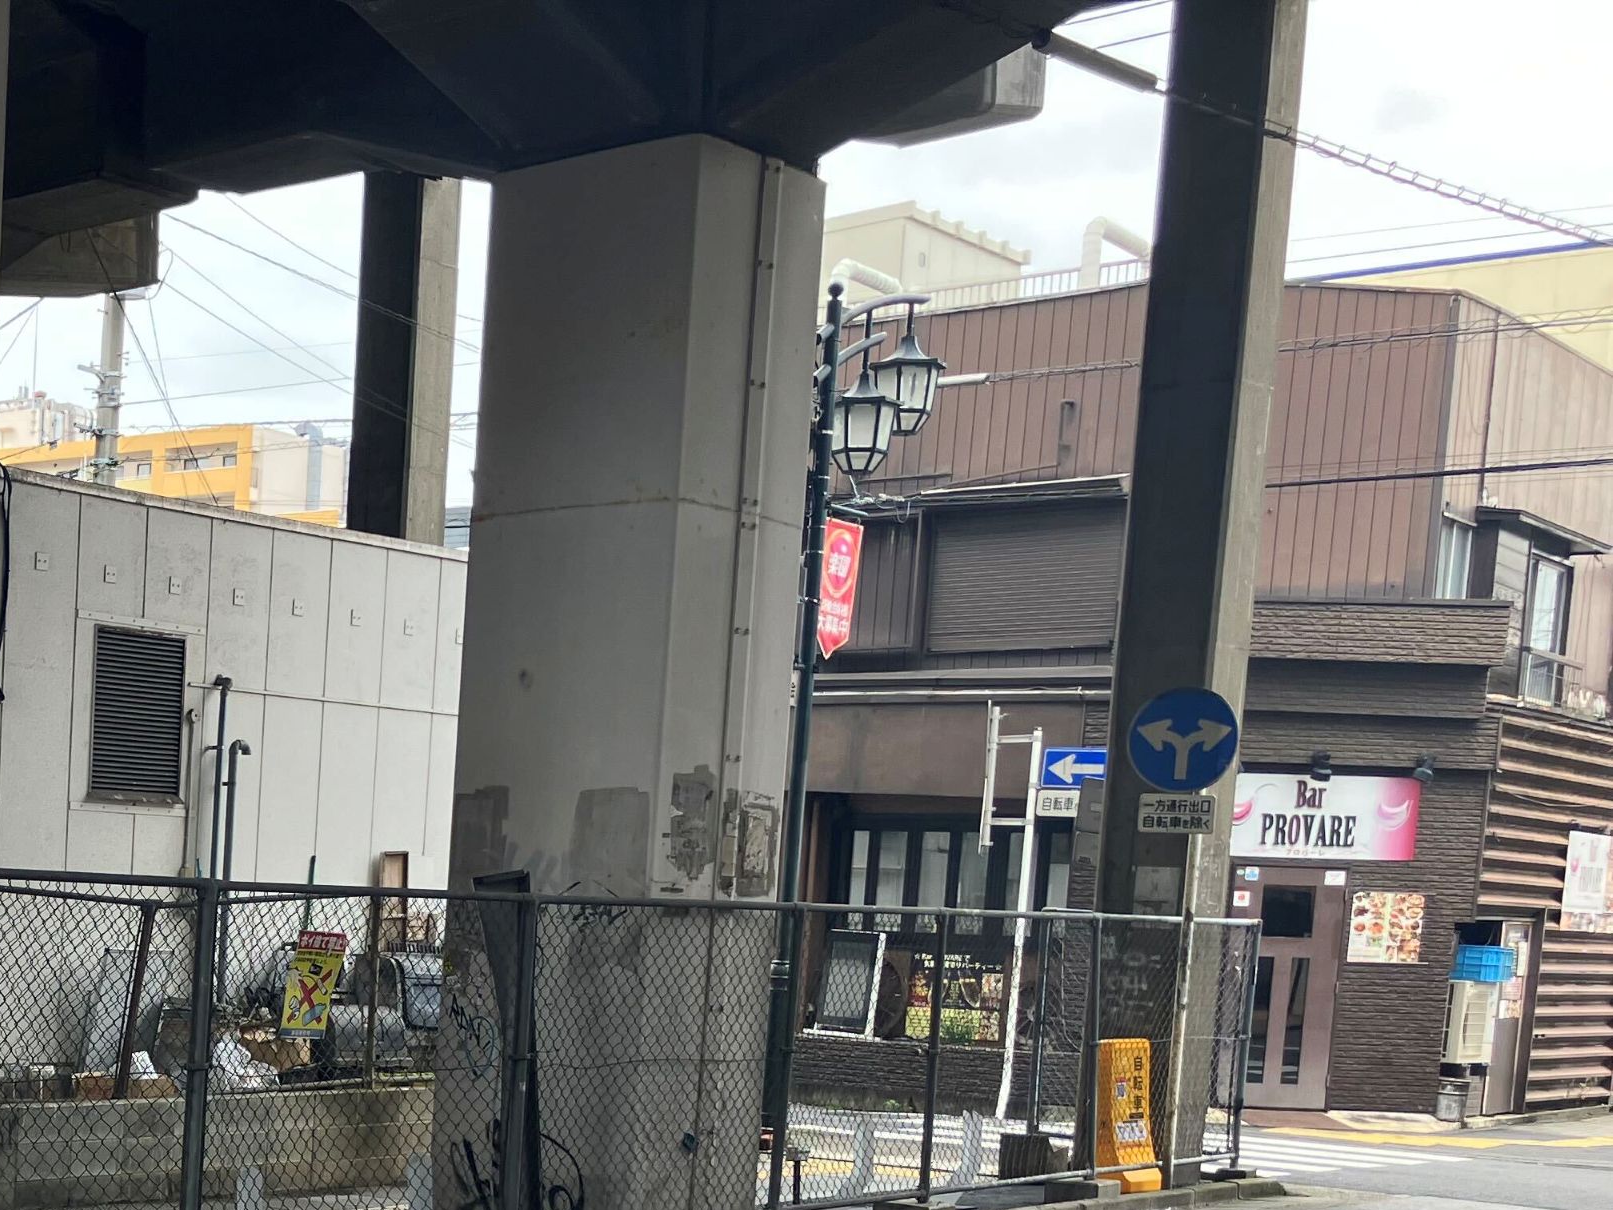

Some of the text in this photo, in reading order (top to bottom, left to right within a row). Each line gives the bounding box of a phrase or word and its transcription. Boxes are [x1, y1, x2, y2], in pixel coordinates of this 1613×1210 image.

[1295, 779, 1327, 809] Bar
[1042, 797, 1079, 811] 自転車
[1143, 799, 1212, 813] 一方通行出口
[1142, 815, 1211, 830] 自転車を除く
[1259, 813, 1357, 848] PROVARE
